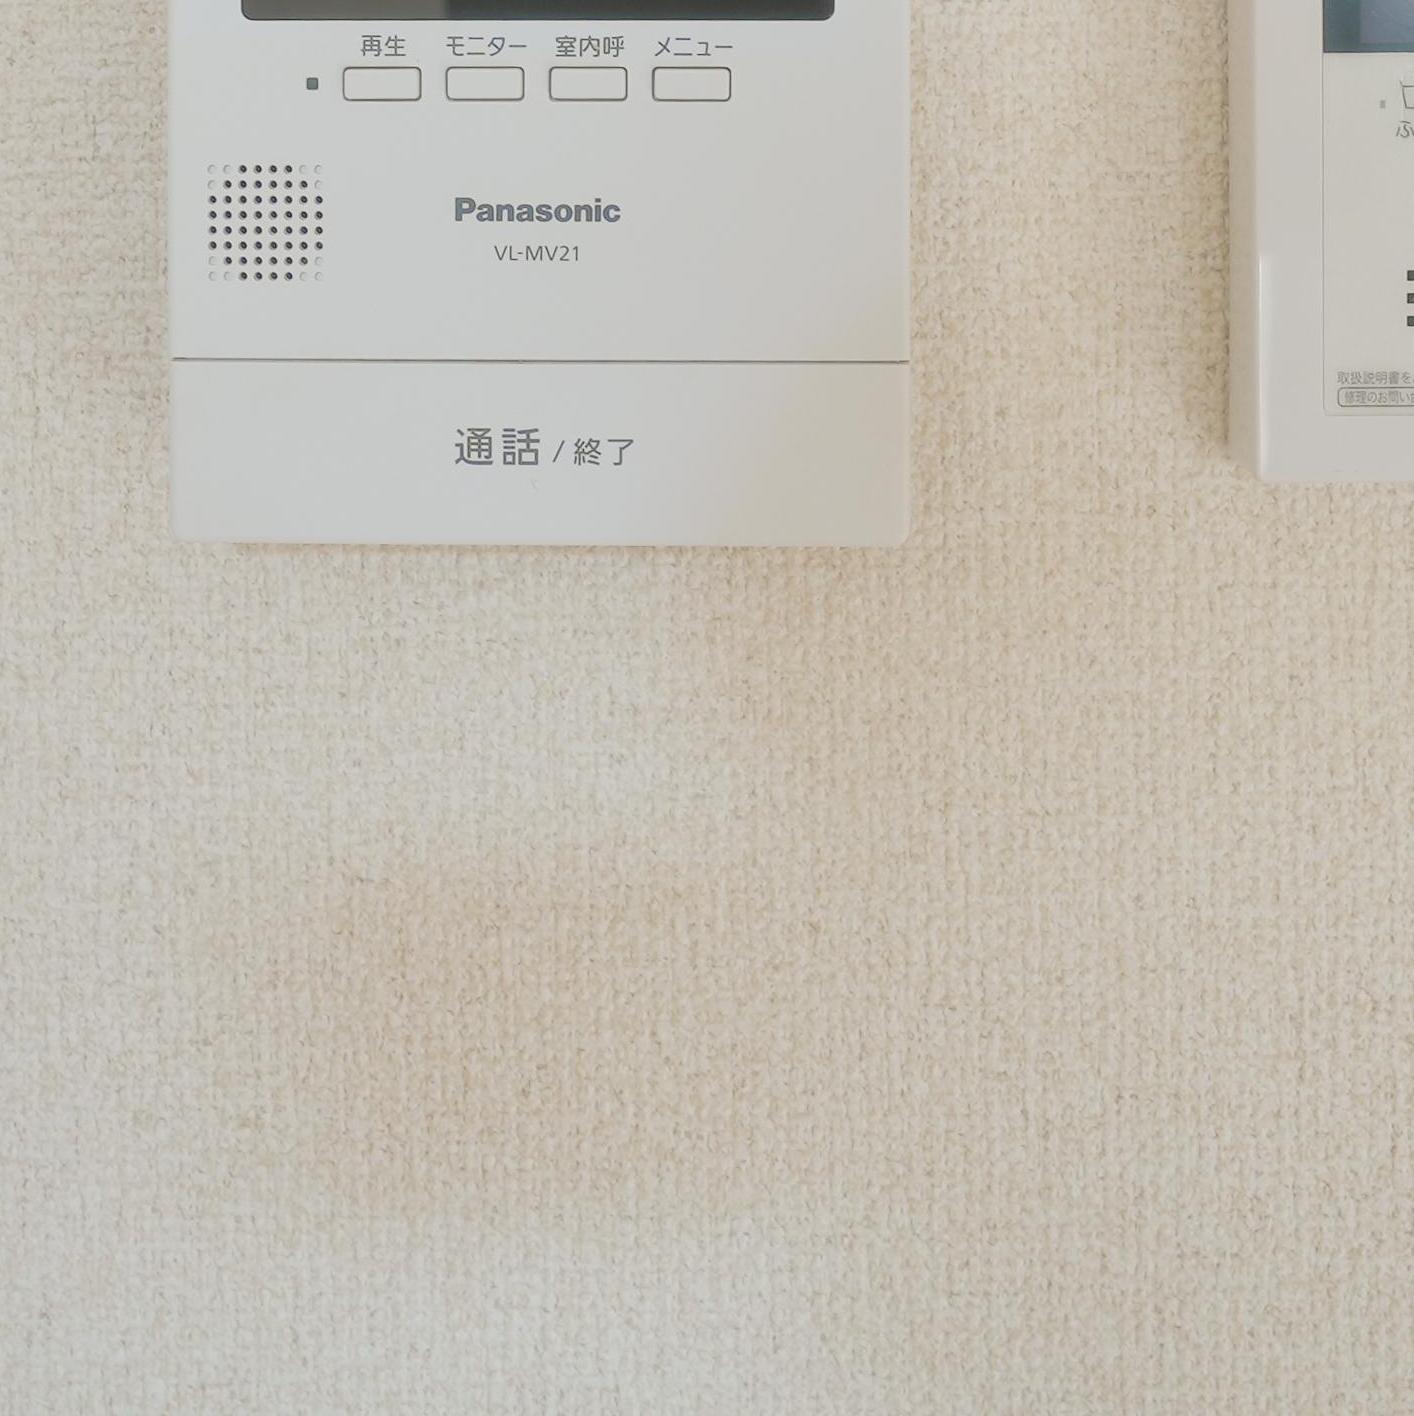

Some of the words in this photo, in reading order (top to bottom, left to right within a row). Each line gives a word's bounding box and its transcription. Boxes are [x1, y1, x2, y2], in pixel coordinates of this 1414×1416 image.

[361, 35, 407, 57] 再生
[446, 35, 527, 57] モニター
[555, 35, 625, 57] 室内呼
[654, 36, 734, 57] メニュー
[455, 197, 621, 222] Panasonic
[494, 245, 579, 261] VL-MV21
[455, 428, 540, 465] 通話
[573, 438, 634, 466] 終了
